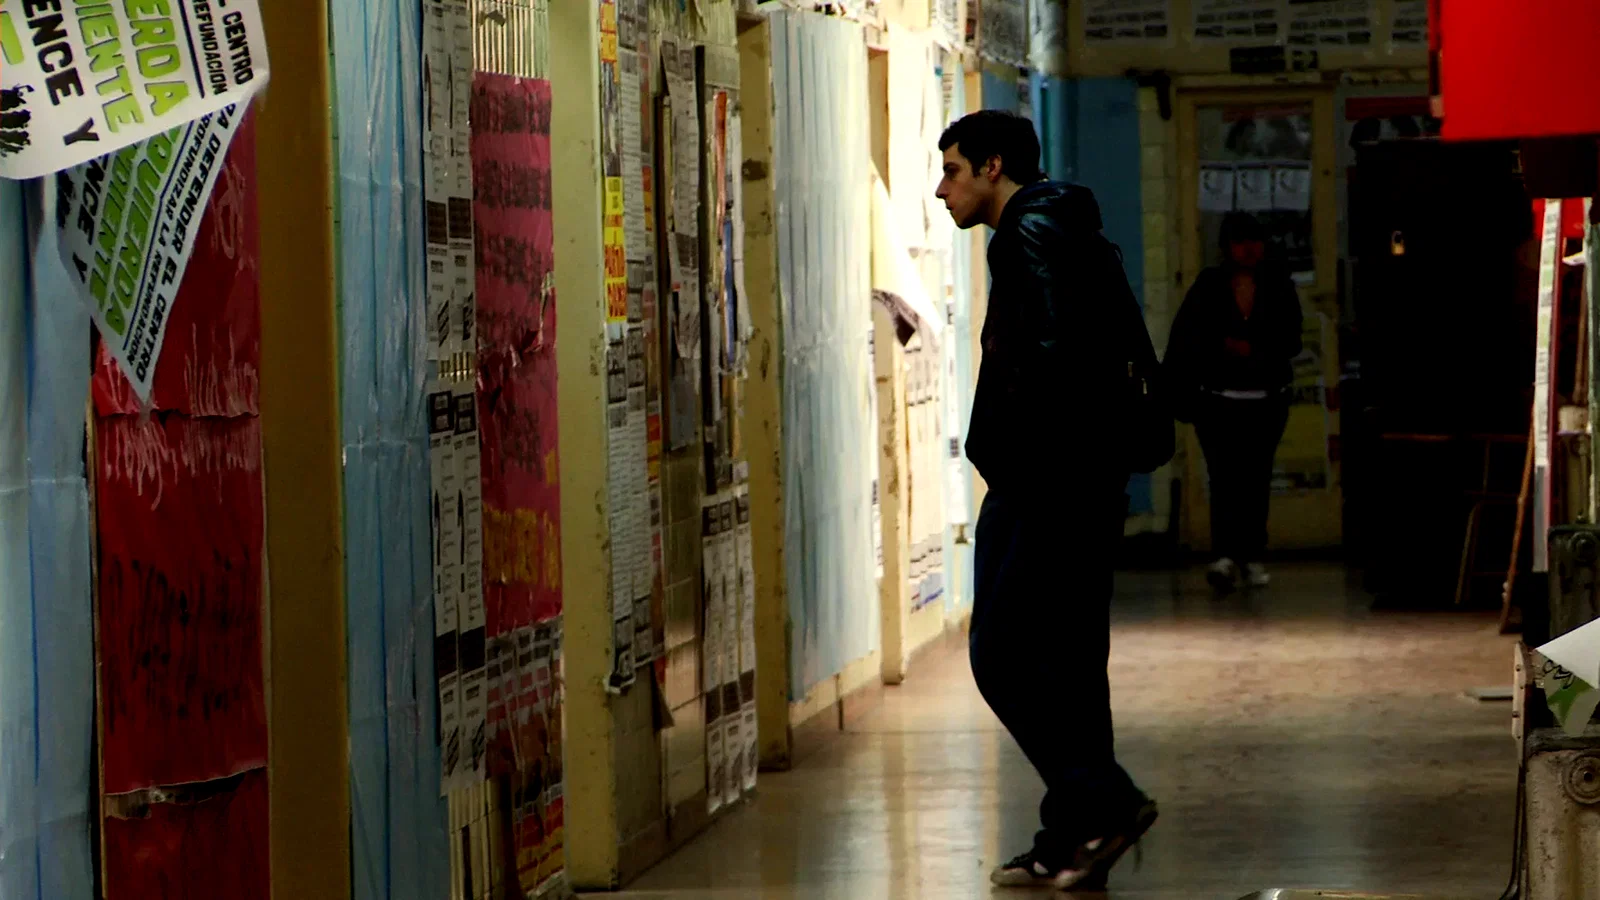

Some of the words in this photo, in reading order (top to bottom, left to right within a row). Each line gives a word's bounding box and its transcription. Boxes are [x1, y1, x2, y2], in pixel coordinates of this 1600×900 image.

[72, 0, 145, 133] IENTE
[223, 11, 254, 85] CENTRO
[62, 117, 100, 146] Y
[165, 112, 214, 221] ROFUNDIZAR
[77, 152, 110, 246] NCE
[158, 221, 170, 247] LA
[171, 133, 221, 255] DEFENDER
[72, 252, 88, 284] Y
[127, 250, 163, 366] REFUNDACION
[161, 256, 178, 286] EL
[136, 293, 167, 383] CENTRO
